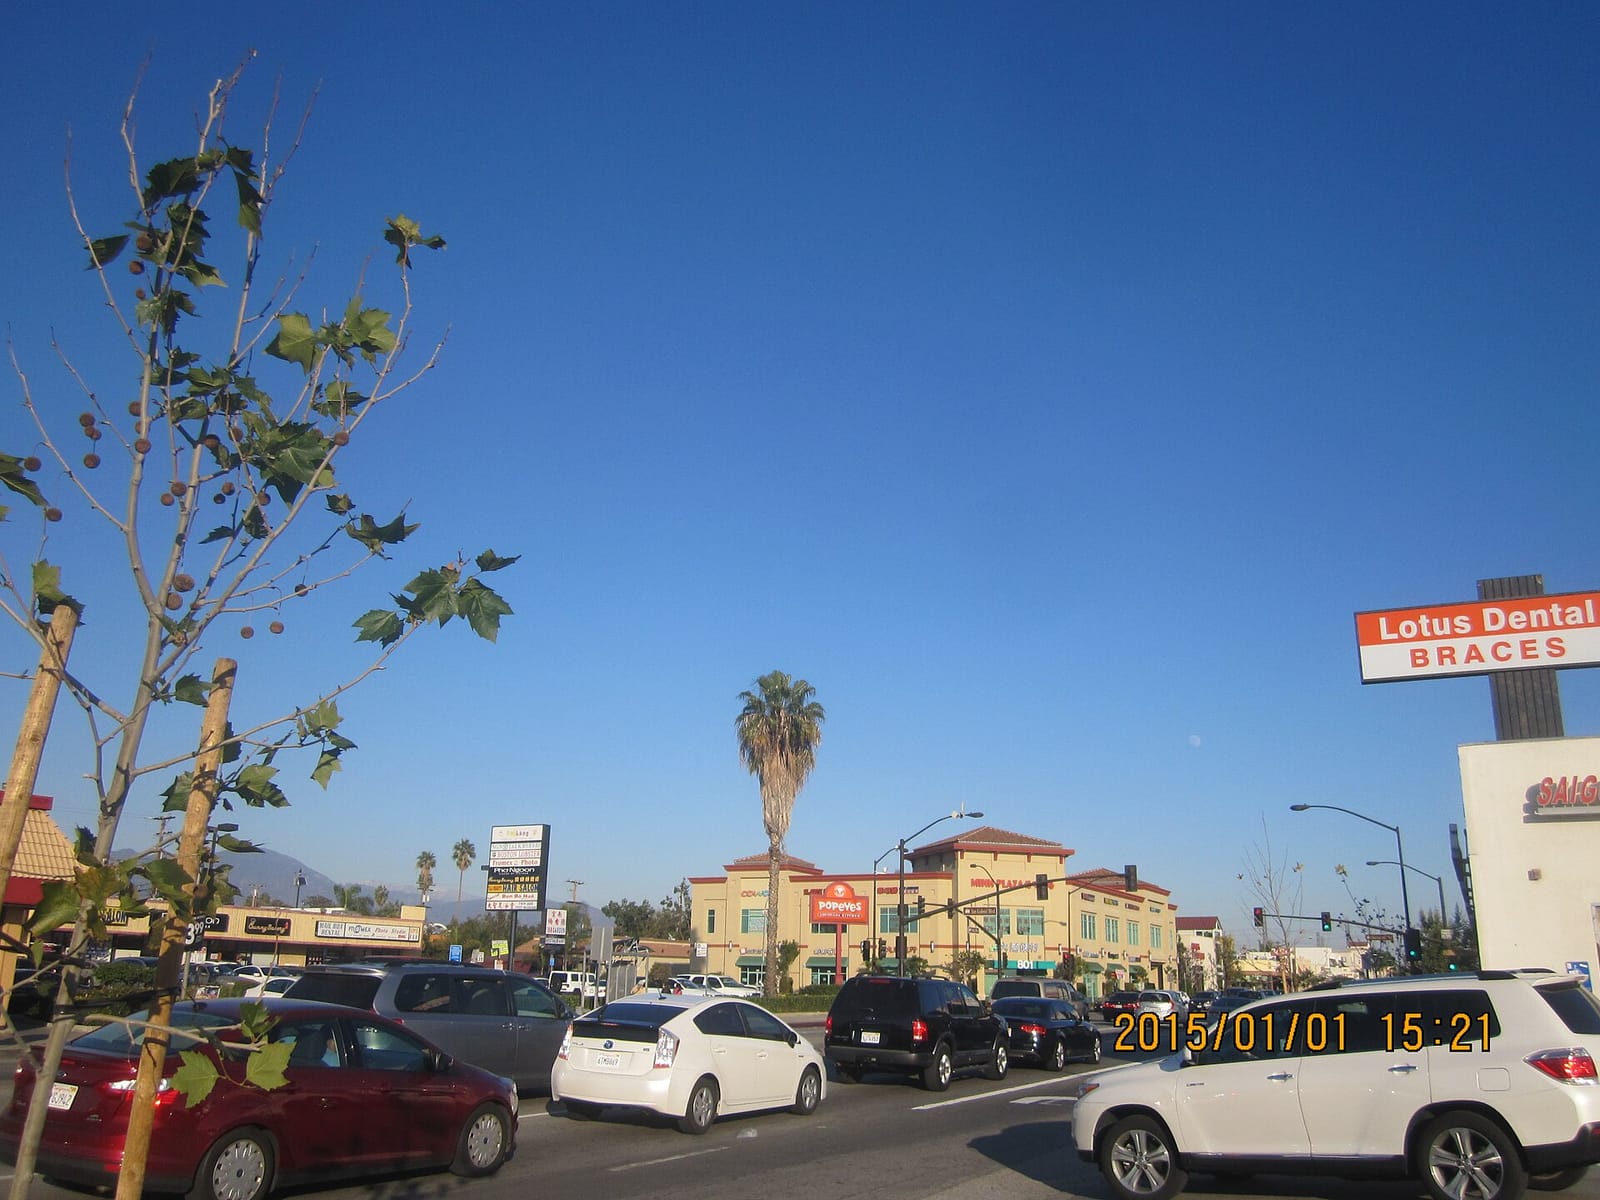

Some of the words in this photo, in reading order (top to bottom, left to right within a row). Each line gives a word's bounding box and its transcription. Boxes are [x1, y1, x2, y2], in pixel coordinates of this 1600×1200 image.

[1378, 614, 1473, 641] Lotus
[1481, 599, 1596, 633] Dental
[1409, 636, 1567, 669] BRACES
[1536, 774, 1600, 806] SAIG
[1017, 960, 1034, 970] 801
